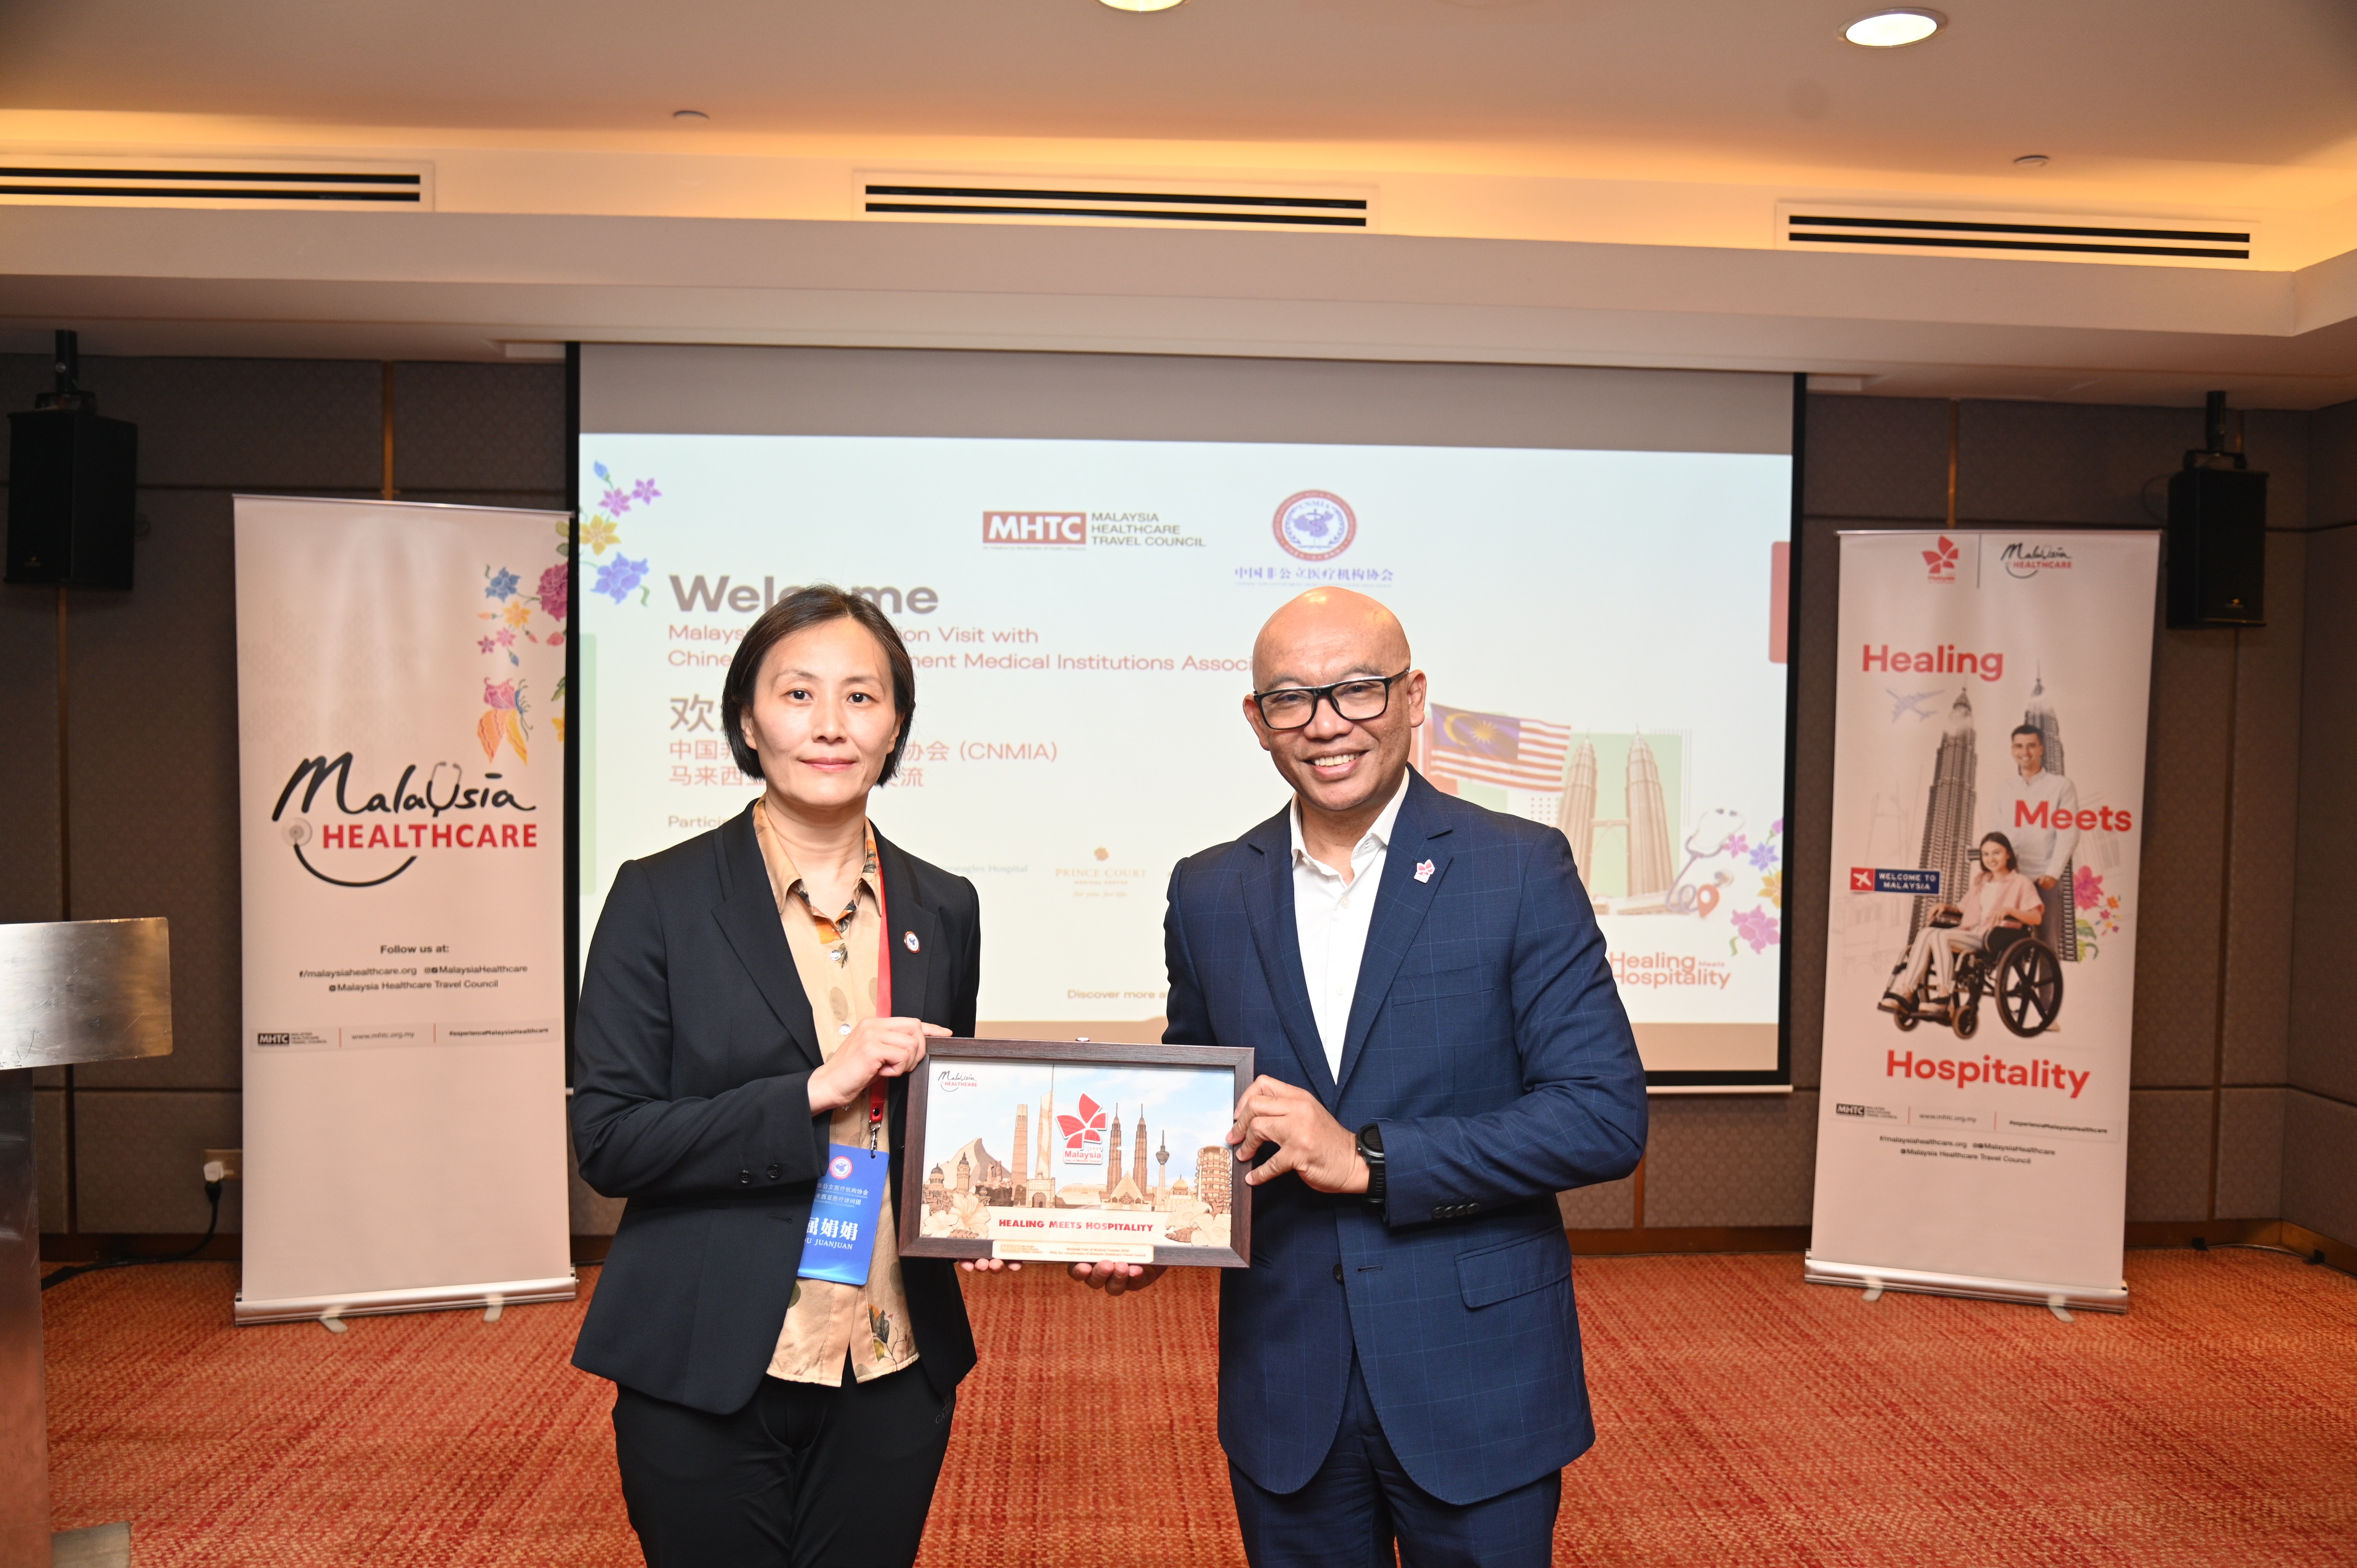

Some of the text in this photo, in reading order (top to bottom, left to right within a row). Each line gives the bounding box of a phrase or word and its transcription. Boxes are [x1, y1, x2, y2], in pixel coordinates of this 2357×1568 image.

[1092, 512, 1159, 523] MALAYSIA
[988, 515, 1081, 540] MHTC
[1092, 524, 1180, 535] HEALTHCARE
[1092, 536, 1207, 547] TRAVEL COUNCIL
[2013, 561, 2073, 569] HEALTHCARE
[1235, 567, 1393, 581] 中国非公立医疗机构协会
[669, 574, 938, 614] Welme
[938, 627, 984, 643] Visit
[992, 627, 1038, 643] with
[668, 650, 733, 666] Chine
[965, 653, 1050, 669] Medical
[1058, 654, 1175, 670] Institutions
[1861, 644, 2004, 682] Healing
[960, 740, 1058, 762] (CNMIA)
[272, 751, 537, 822] Malaysia
[2014, 799, 2133, 833] Meets
[322, 824, 538, 849] HEALTHCARE
[989, 865, 1028, 874] Hospital
[1055, 868, 1147, 878] PRINCE COURT
[1879, 872, 1936, 883] WELCOME TO
[1883, 881, 1931, 891] MALAYSIA
[380, 945, 416, 954] Follow
[436, 945, 449, 953] at:
[1610, 952, 1696, 973] Healing
[337, 979, 499, 993] Malaysia Healthcare Travel Council
[1068, 990, 1120, 999] Discover
[259, 1034, 289, 1044] MHTC
[351, 1030, 415, 1040] www.mhtc.org.my
[938, 1070, 977, 1081] Malaysia
[1885, 1049, 2091, 1099] Hospitality
[1837, 1104, 1864, 1115] MHTC
[1919, 1112, 1977, 1124] www.mhtc.org.my
[1065, 1151, 1101, 1160] Malaysia
[1980, 1153, 2002, 1162] Travel
[2003, 1155, 2031, 1164] Council
[999, 1219, 1154, 1232] HEALING MEETS HOSPITALITY
[815, 1239, 853, 1250] JUANJUAN
